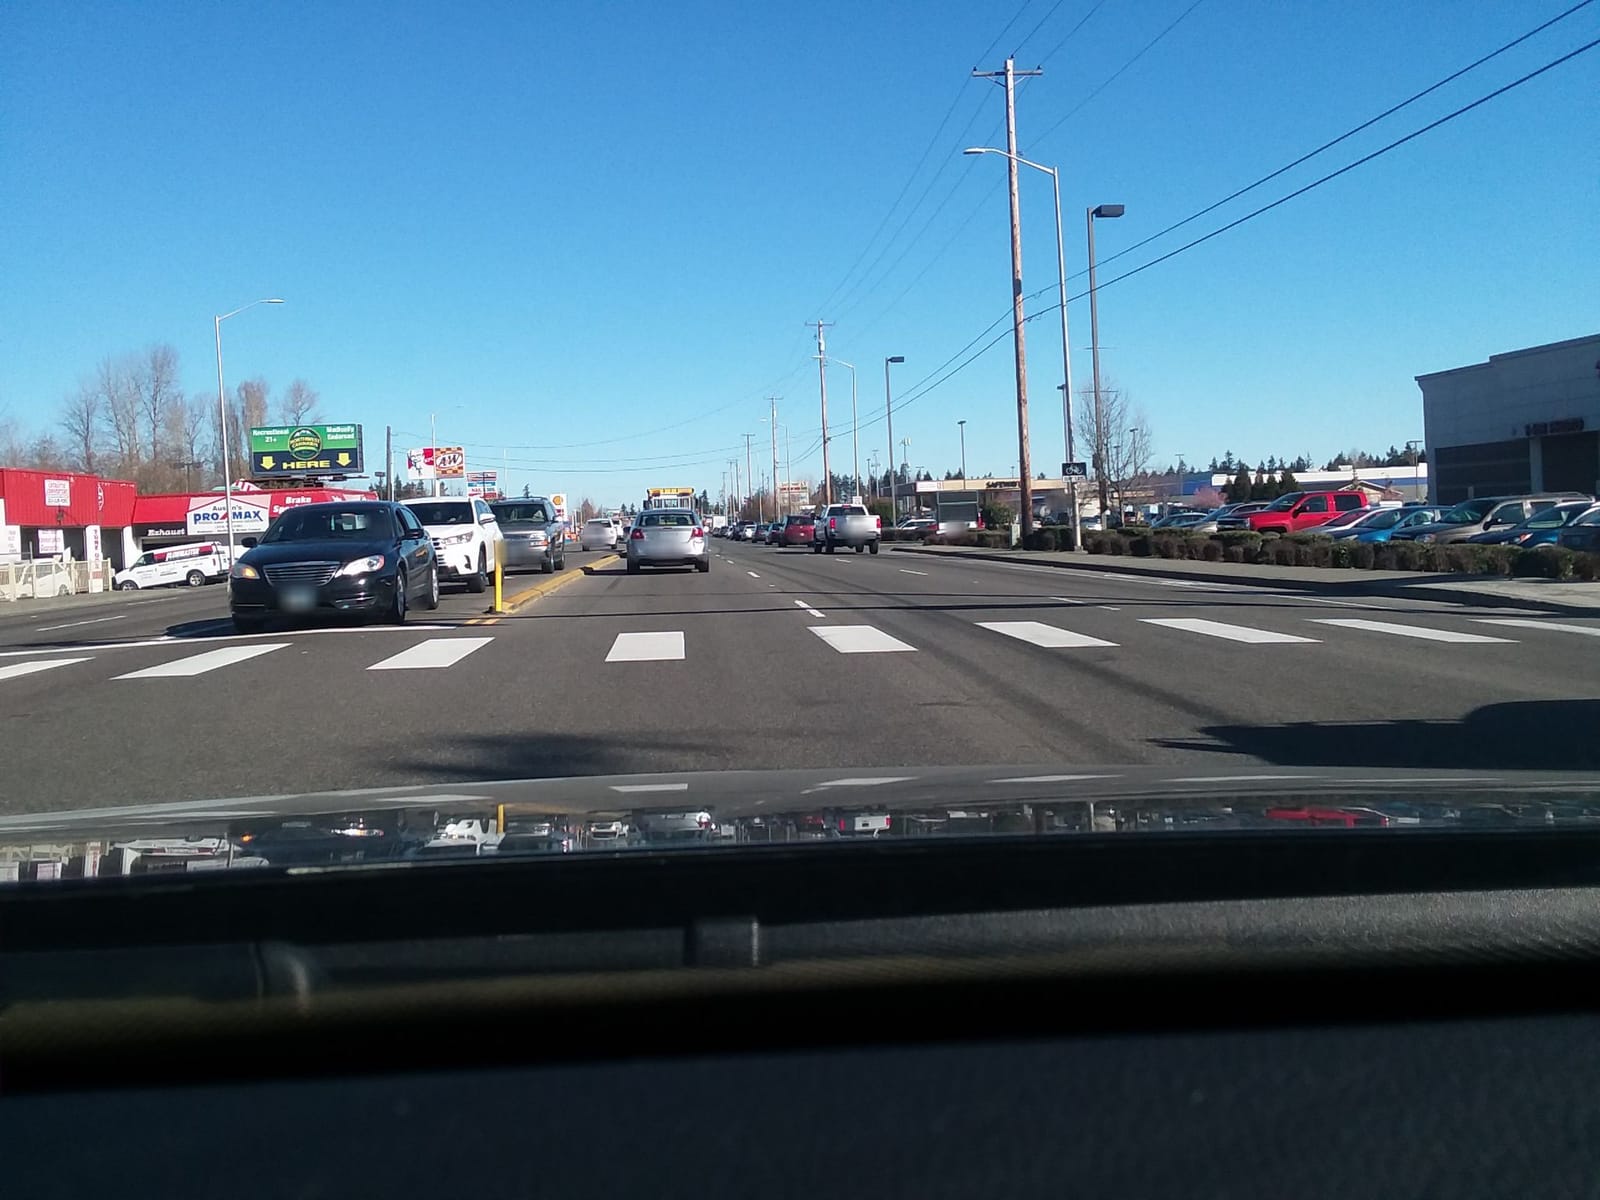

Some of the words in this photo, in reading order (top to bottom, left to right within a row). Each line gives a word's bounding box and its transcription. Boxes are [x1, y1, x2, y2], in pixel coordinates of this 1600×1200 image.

[282, 460, 330, 469] HERE
[286, 496, 311, 504] Brake
[147, 528, 186, 536] Exhaust
